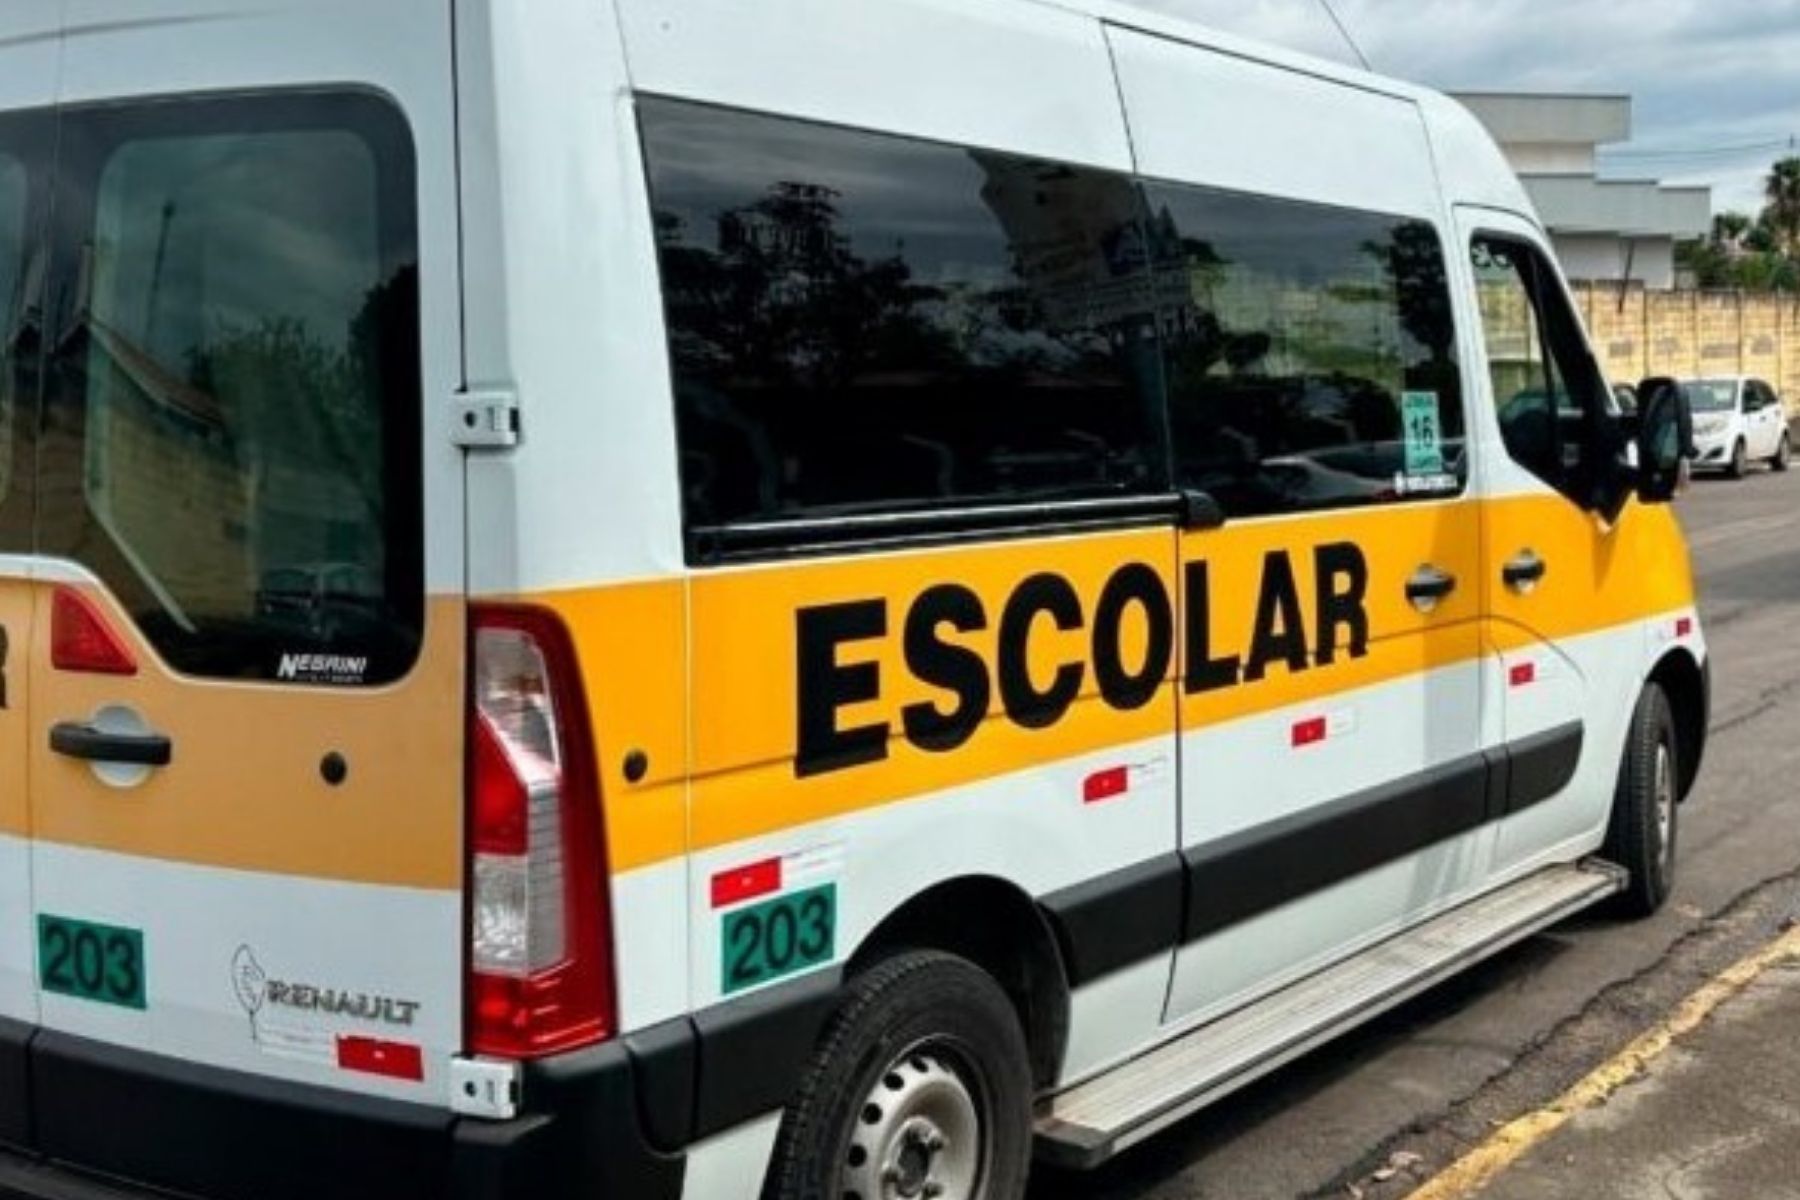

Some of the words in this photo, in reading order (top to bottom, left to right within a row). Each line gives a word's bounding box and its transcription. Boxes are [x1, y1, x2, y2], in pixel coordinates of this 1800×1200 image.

[794, 541, 1369, 779] ESCOLAR
[43, 921, 138, 1000] 203
[731, 894, 830, 982] 203
[267, 979, 421, 1026] RENAULT
